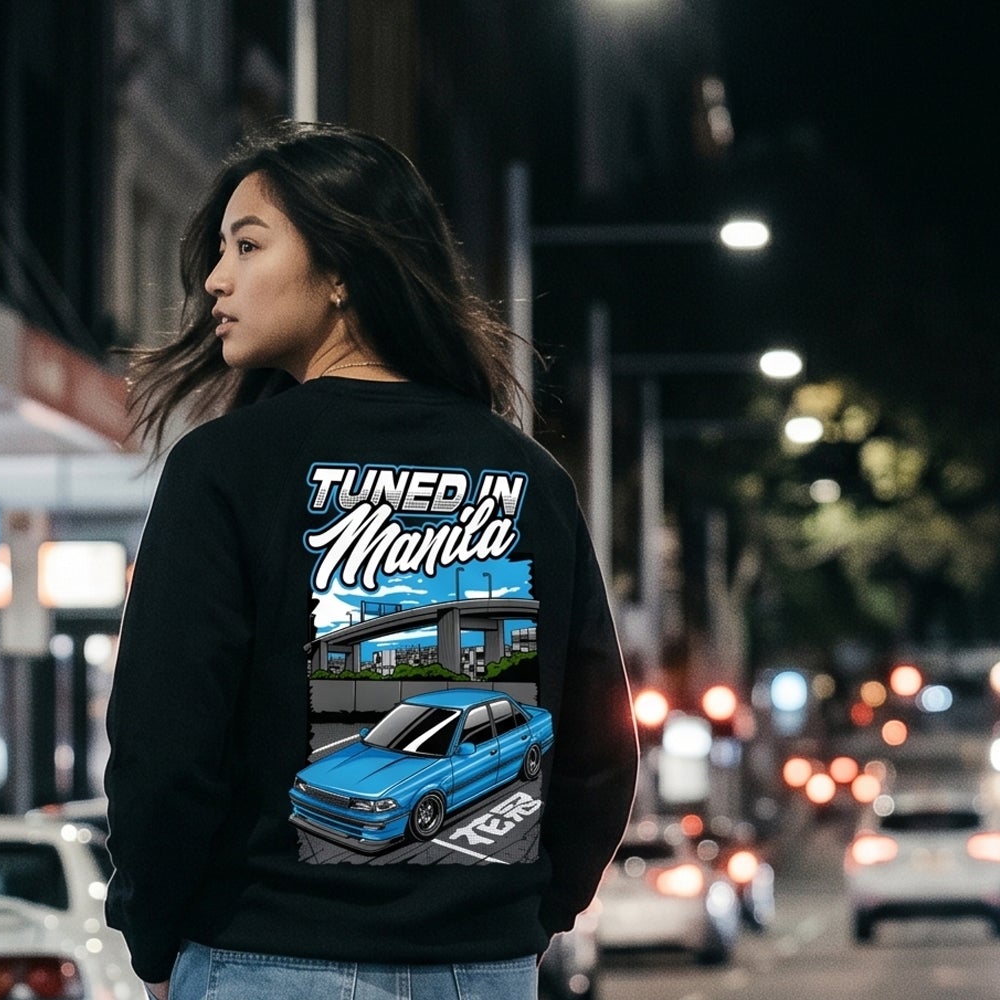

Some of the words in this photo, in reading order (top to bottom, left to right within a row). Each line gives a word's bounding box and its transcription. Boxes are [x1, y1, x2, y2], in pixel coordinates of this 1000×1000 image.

[311, 467, 468, 512] TUNED
[475, 474, 525, 517] IN
[308, 496, 516, 590] Manila
